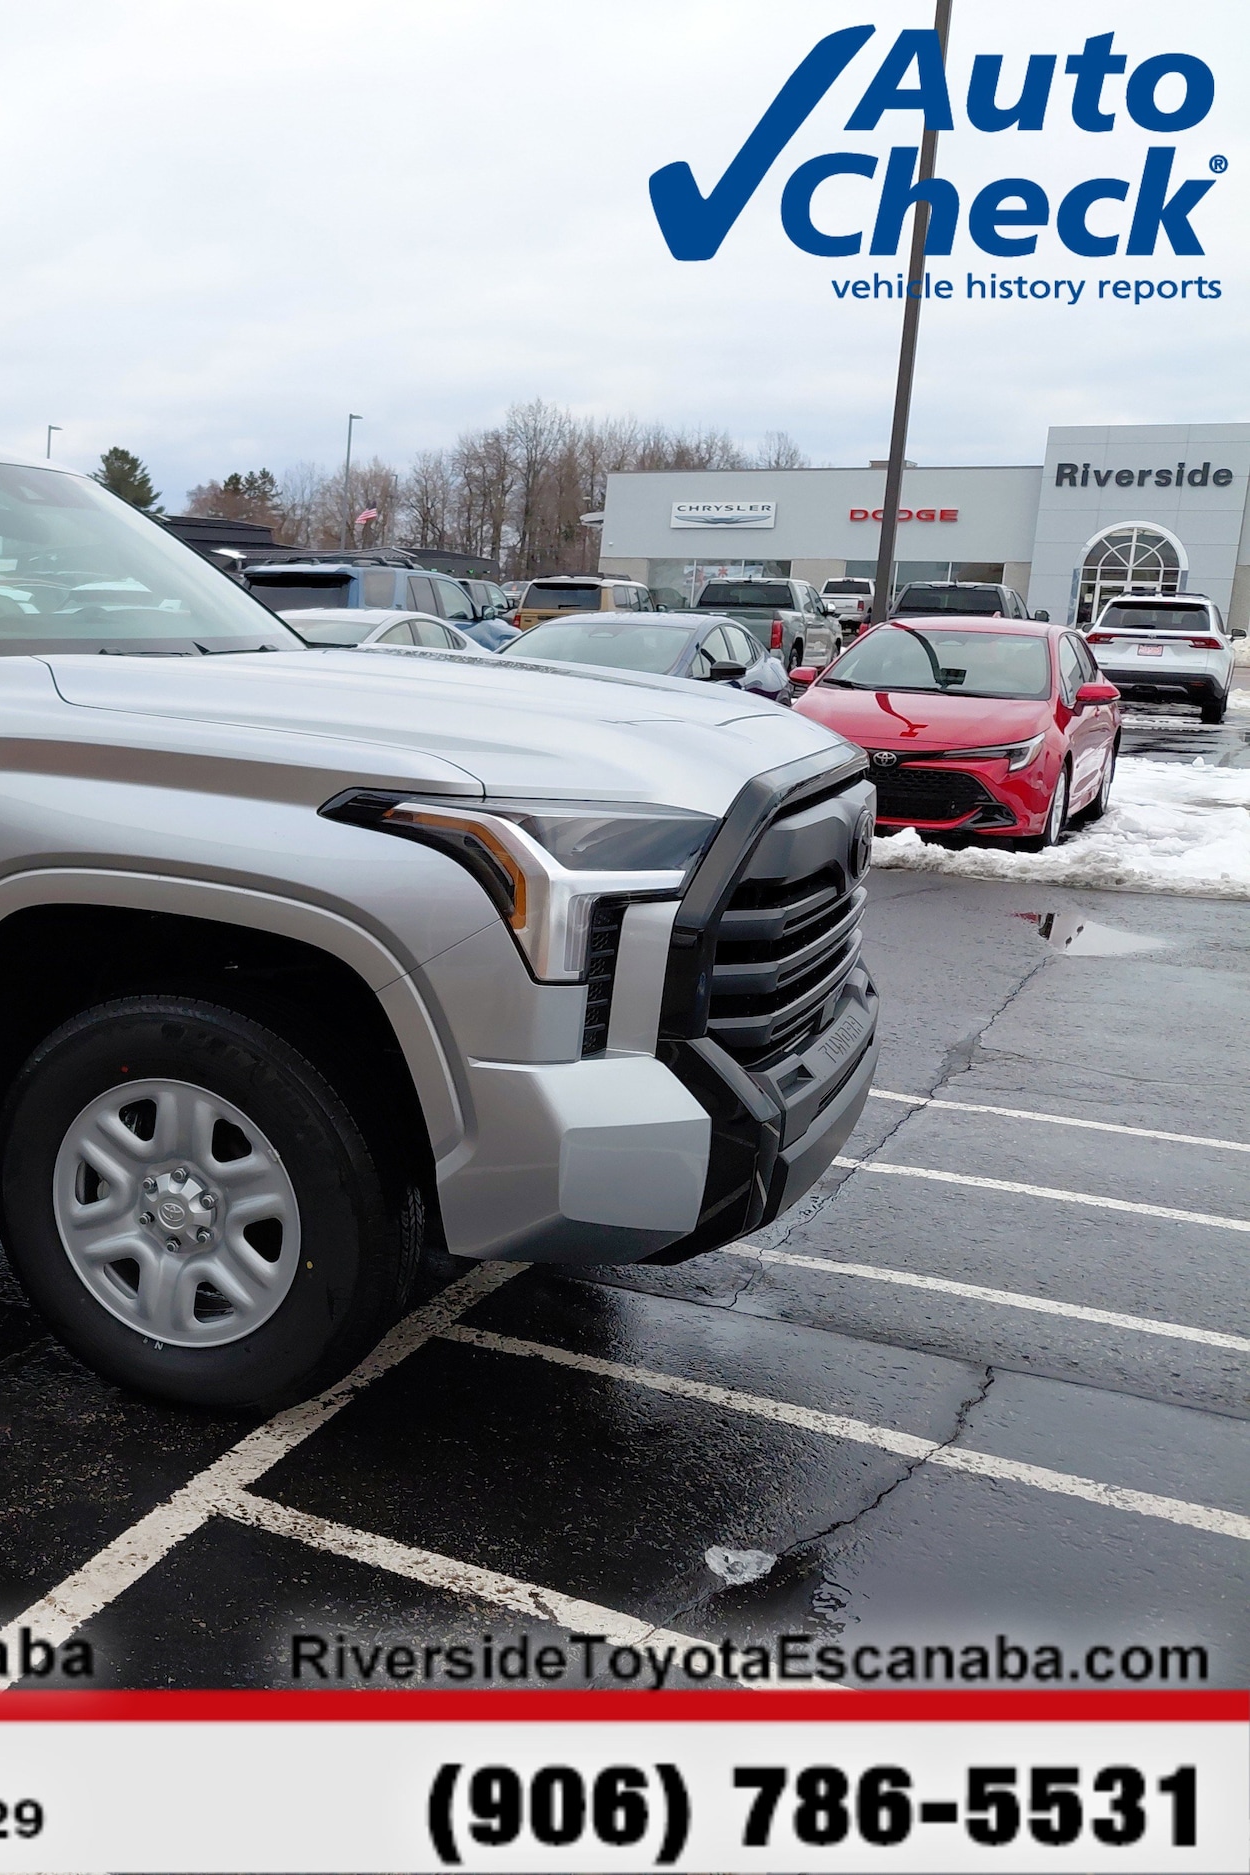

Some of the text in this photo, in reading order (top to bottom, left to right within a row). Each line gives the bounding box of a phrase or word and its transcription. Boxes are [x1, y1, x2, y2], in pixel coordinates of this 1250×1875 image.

[1055, 461, 1233, 488] Riverside
[677, 504, 772, 512] CHRYSLER
[817, 1015, 864, 1064] TUNDRA
